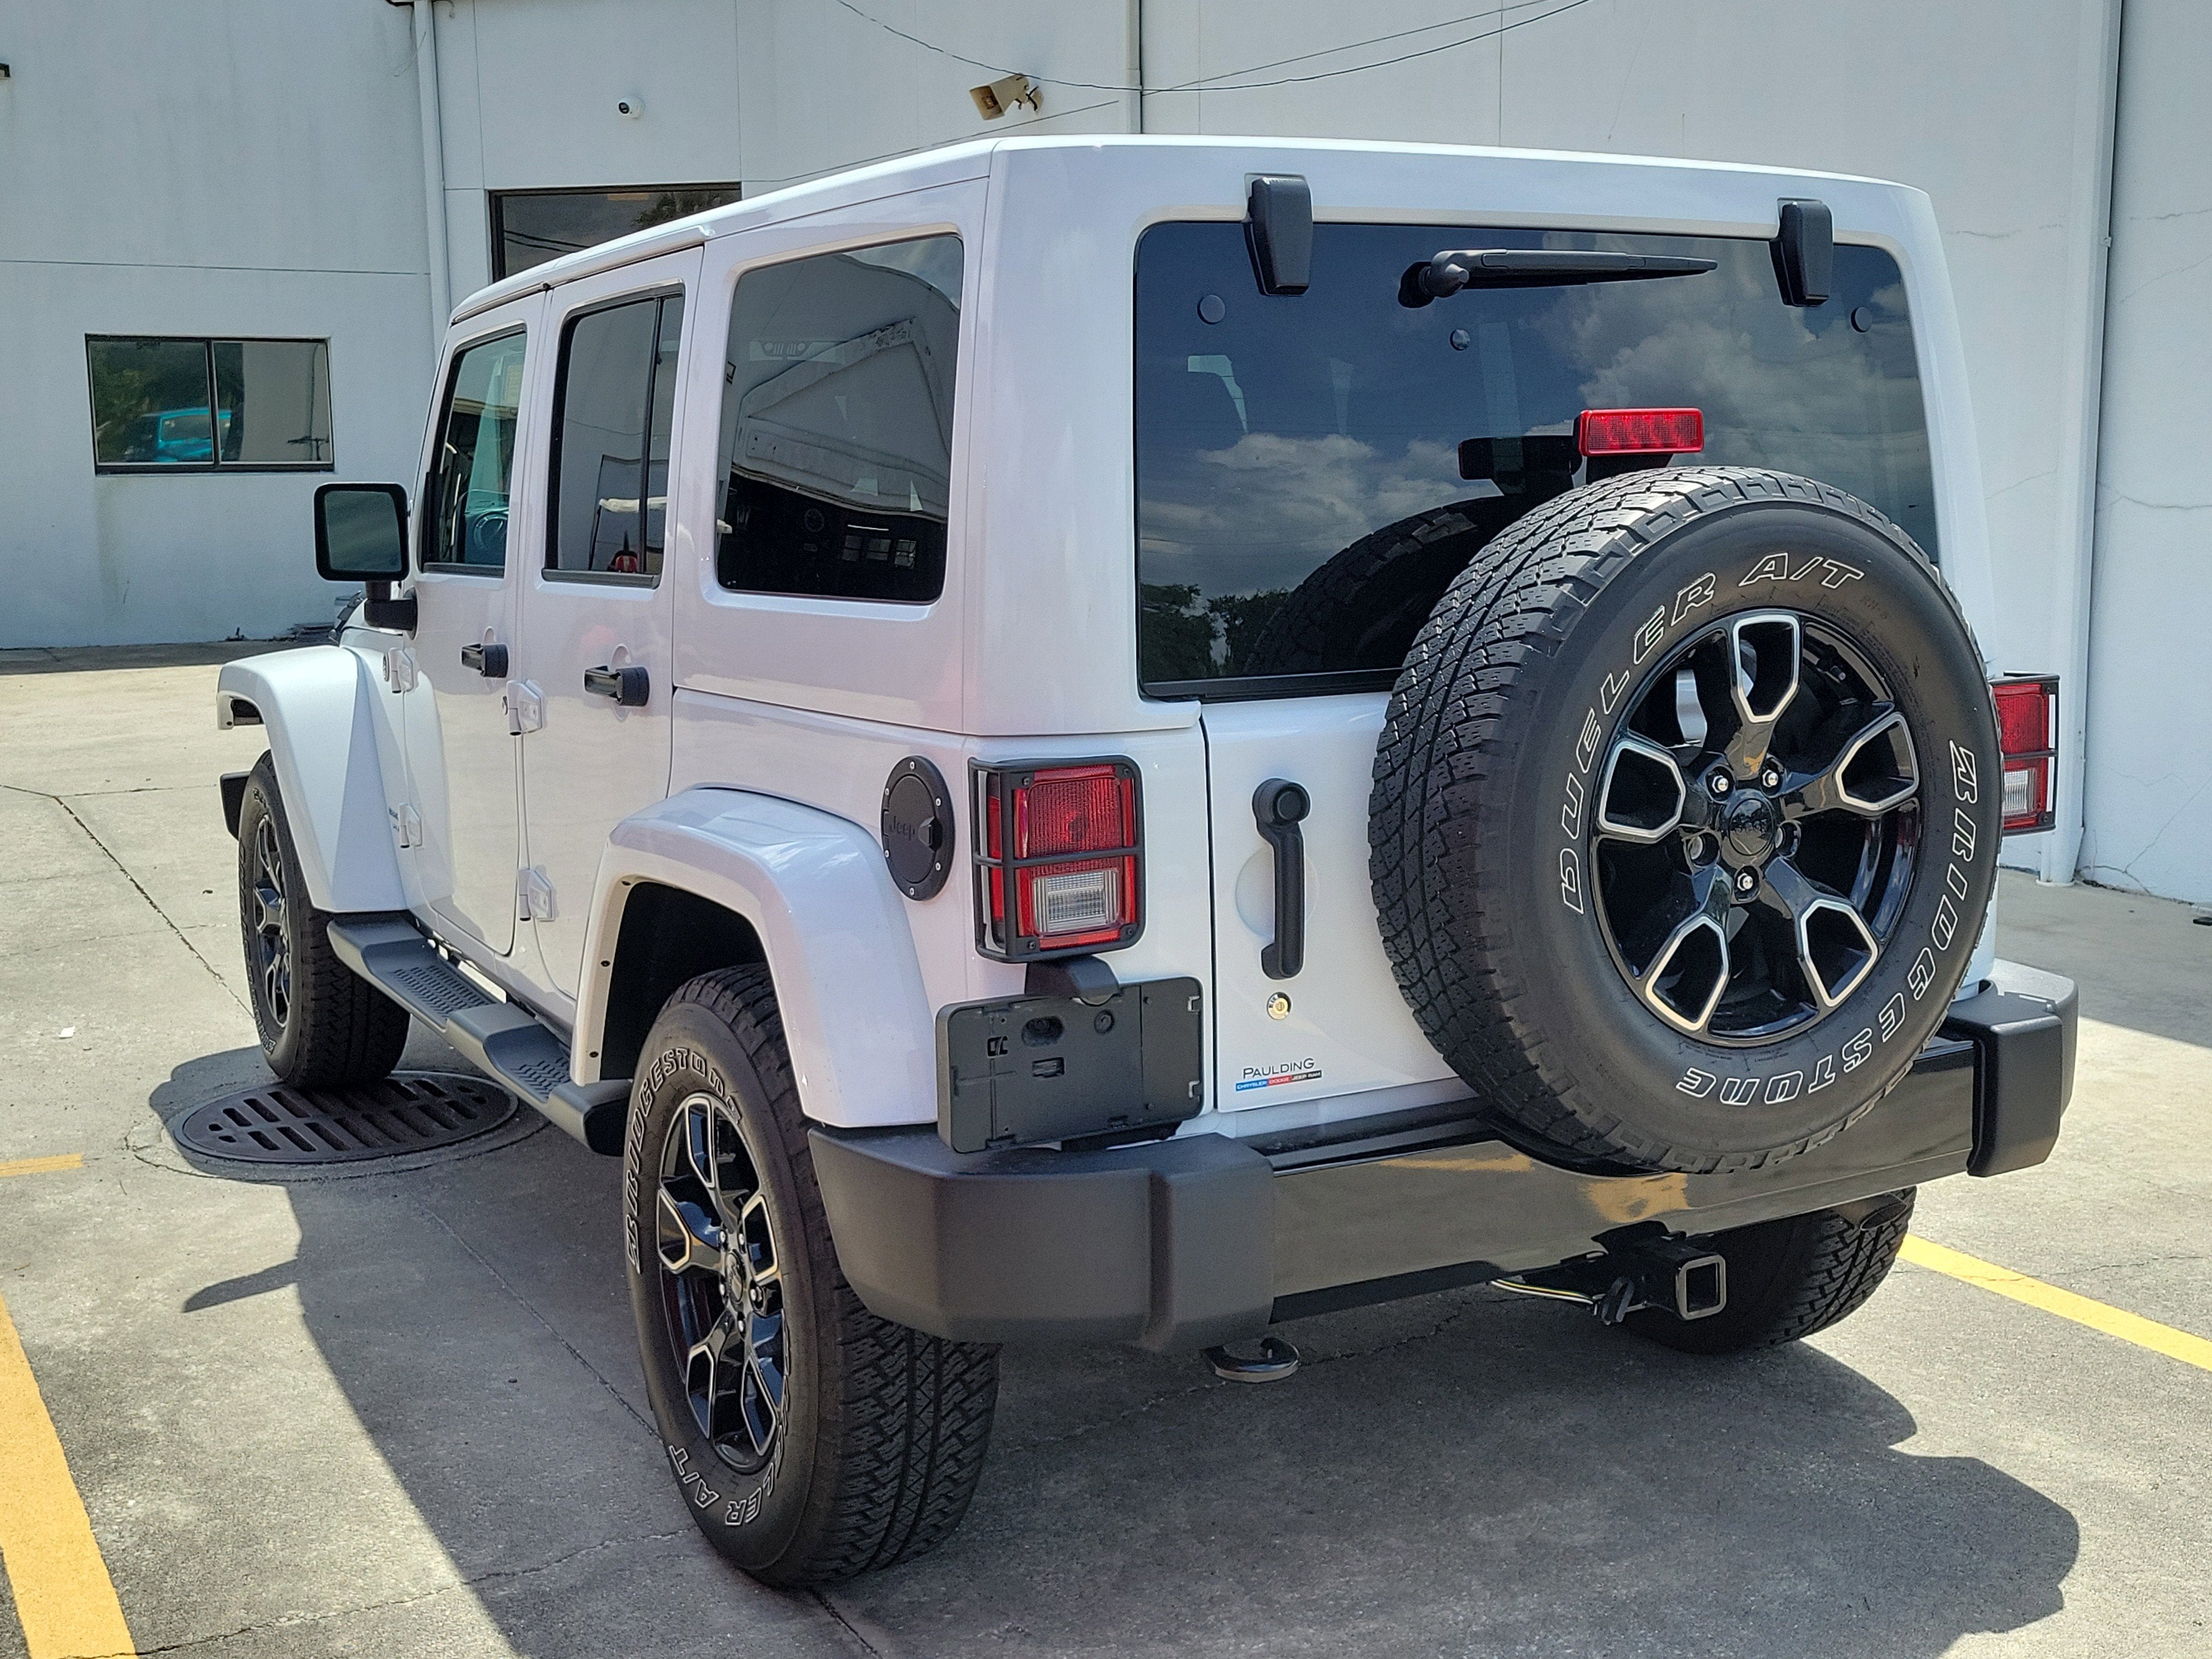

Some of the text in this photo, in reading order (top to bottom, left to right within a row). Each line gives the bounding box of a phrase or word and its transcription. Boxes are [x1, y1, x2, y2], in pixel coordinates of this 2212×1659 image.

[1560, 552, 1865, 914] DUELER A/T
[1675, 740, 1978, 1105] BRIDGESTONE
[1237, 1080, 1267, 1090] CHRYSLER
[1243, 1057, 1315, 1079] PAULDING
[668, 1444, 720, 1509] A/T
